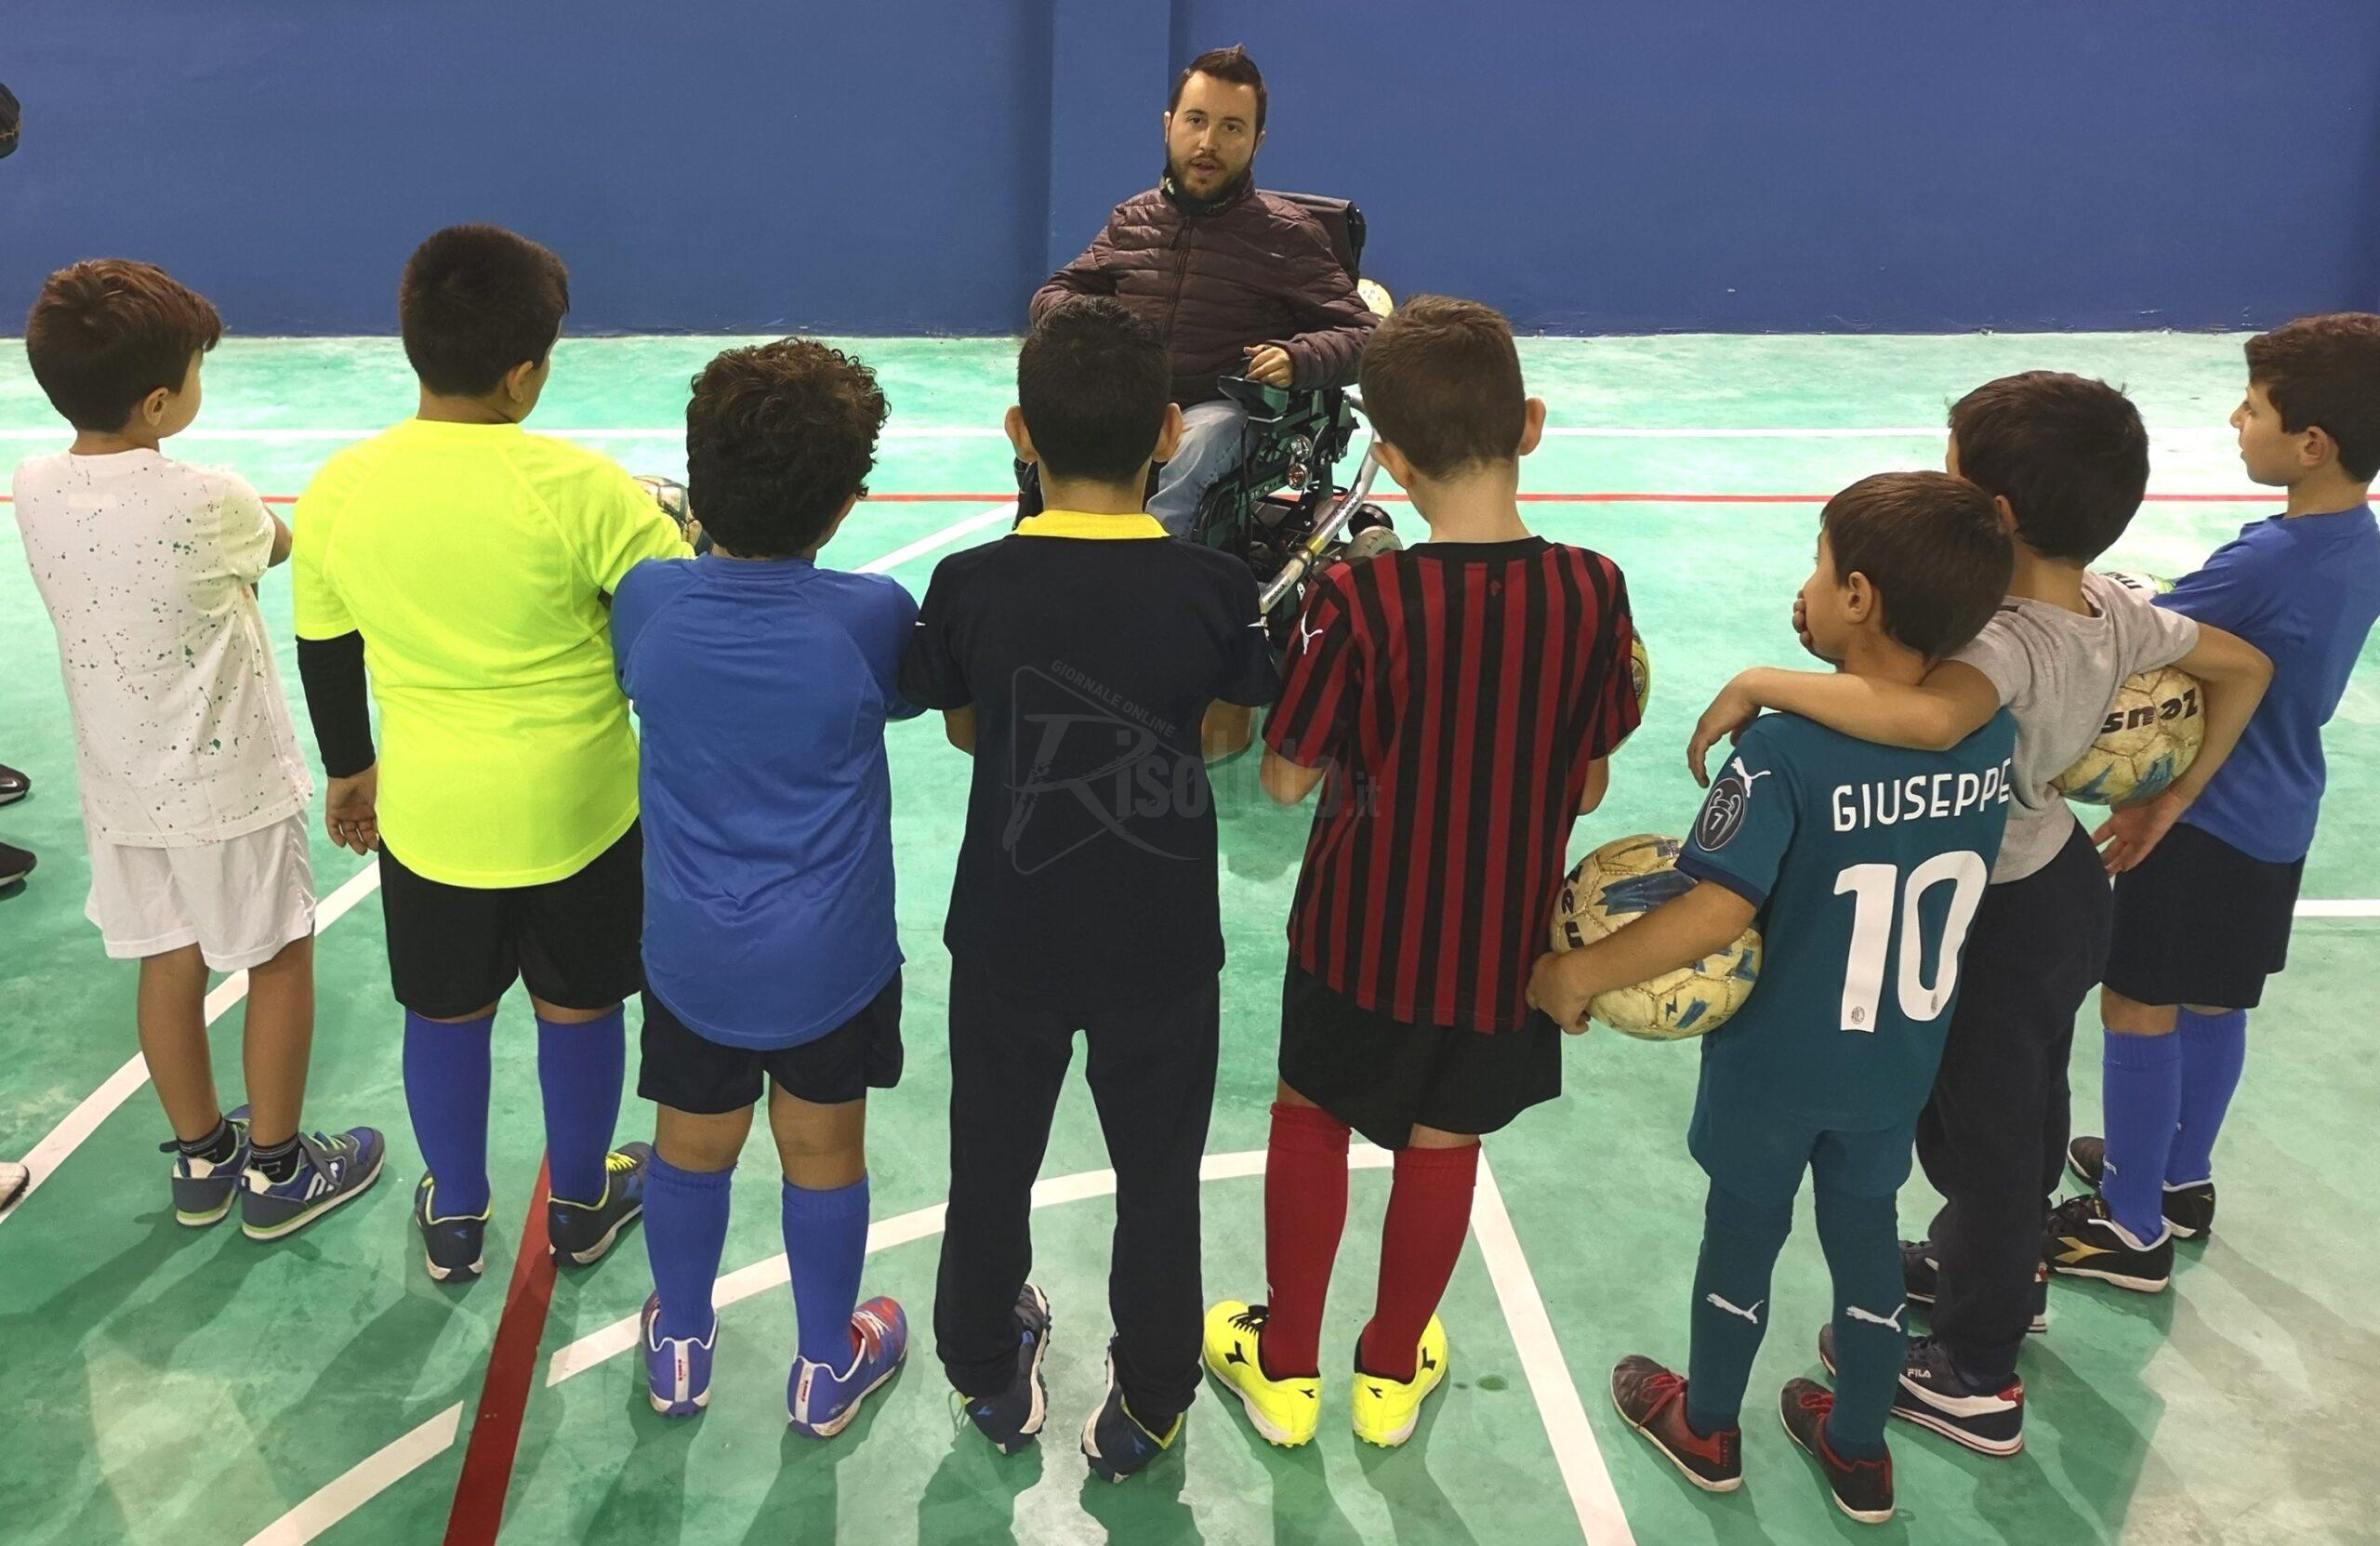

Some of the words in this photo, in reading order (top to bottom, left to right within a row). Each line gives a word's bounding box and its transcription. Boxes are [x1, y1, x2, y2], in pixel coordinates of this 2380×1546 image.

[1832, 758, 2012, 832] GIUSEPPE
[1710, 812, 1725, 830] 7
[1832, 850, 1988, 1034] 10
[1907, 1368, 1932, 1379] FILA
